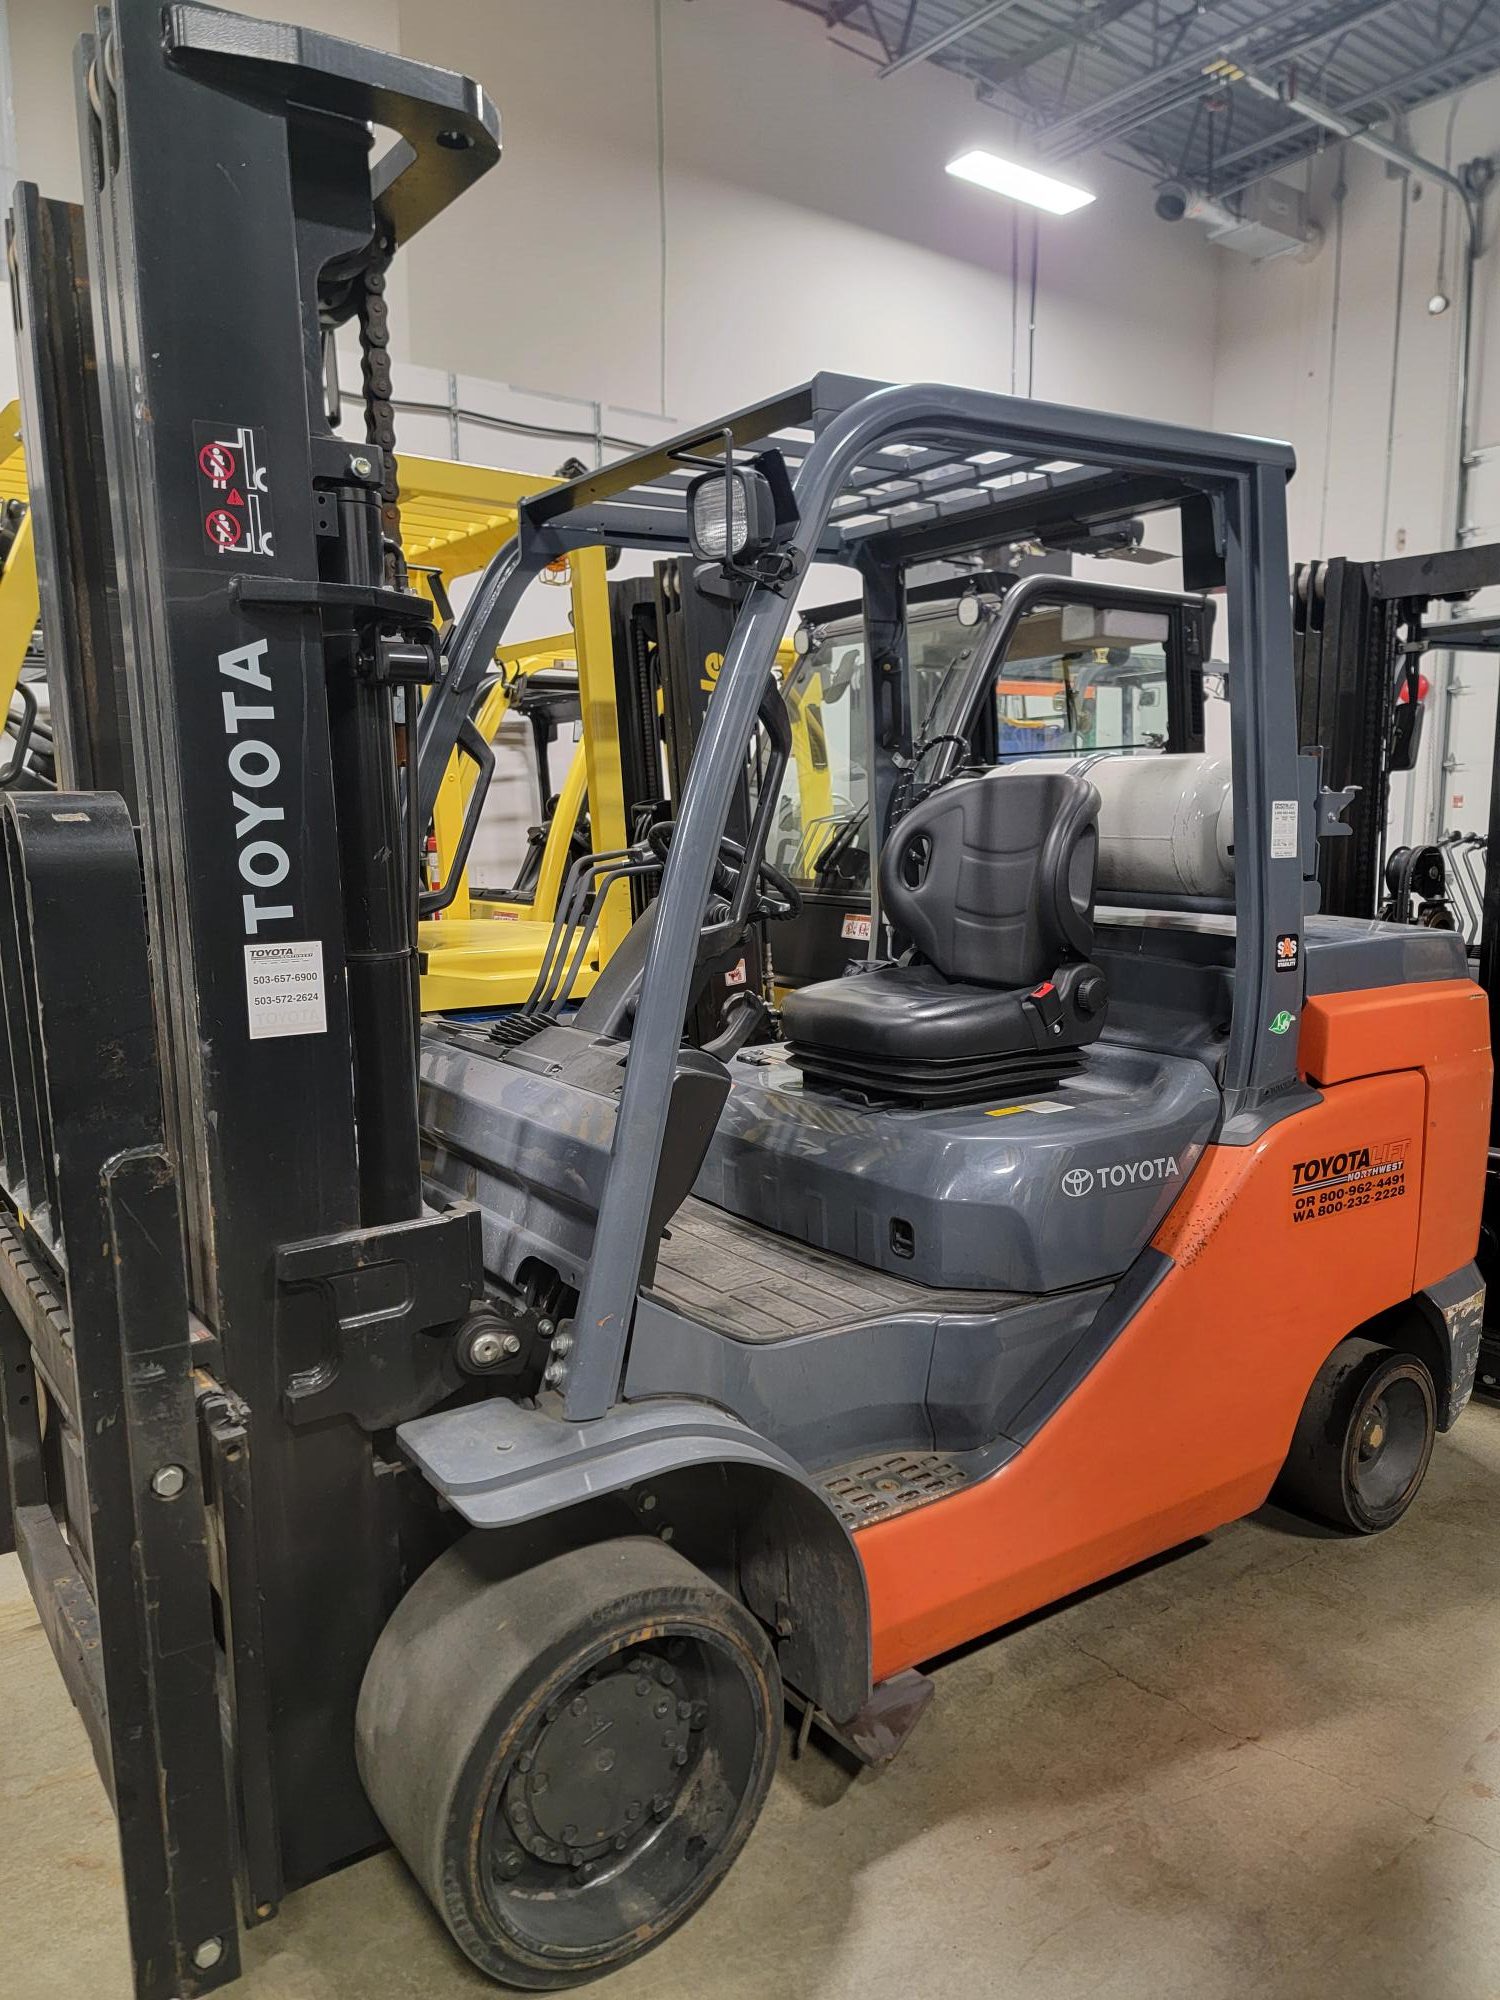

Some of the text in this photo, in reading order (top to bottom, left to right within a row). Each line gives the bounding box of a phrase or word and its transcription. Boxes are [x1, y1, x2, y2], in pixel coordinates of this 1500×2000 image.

[218, 638, 294, 935] TOYOTA
[250, 948, 294, 957] TOYOTA
[1277, 937, 1297, 958] SAS
[253, 972, 318, 985] 503-657-6900
[254, 992, 319, 1006] 503-572-2624
[1096, 1156, 1179, 1189] TOYOTA
[1347, 1161, 1404, 1183] NORTHWEST
[1295, 1173, 1405, 1210] OR 800-962-4491
[1293, 1186, 1405, 1223] WA 800-232-2228
